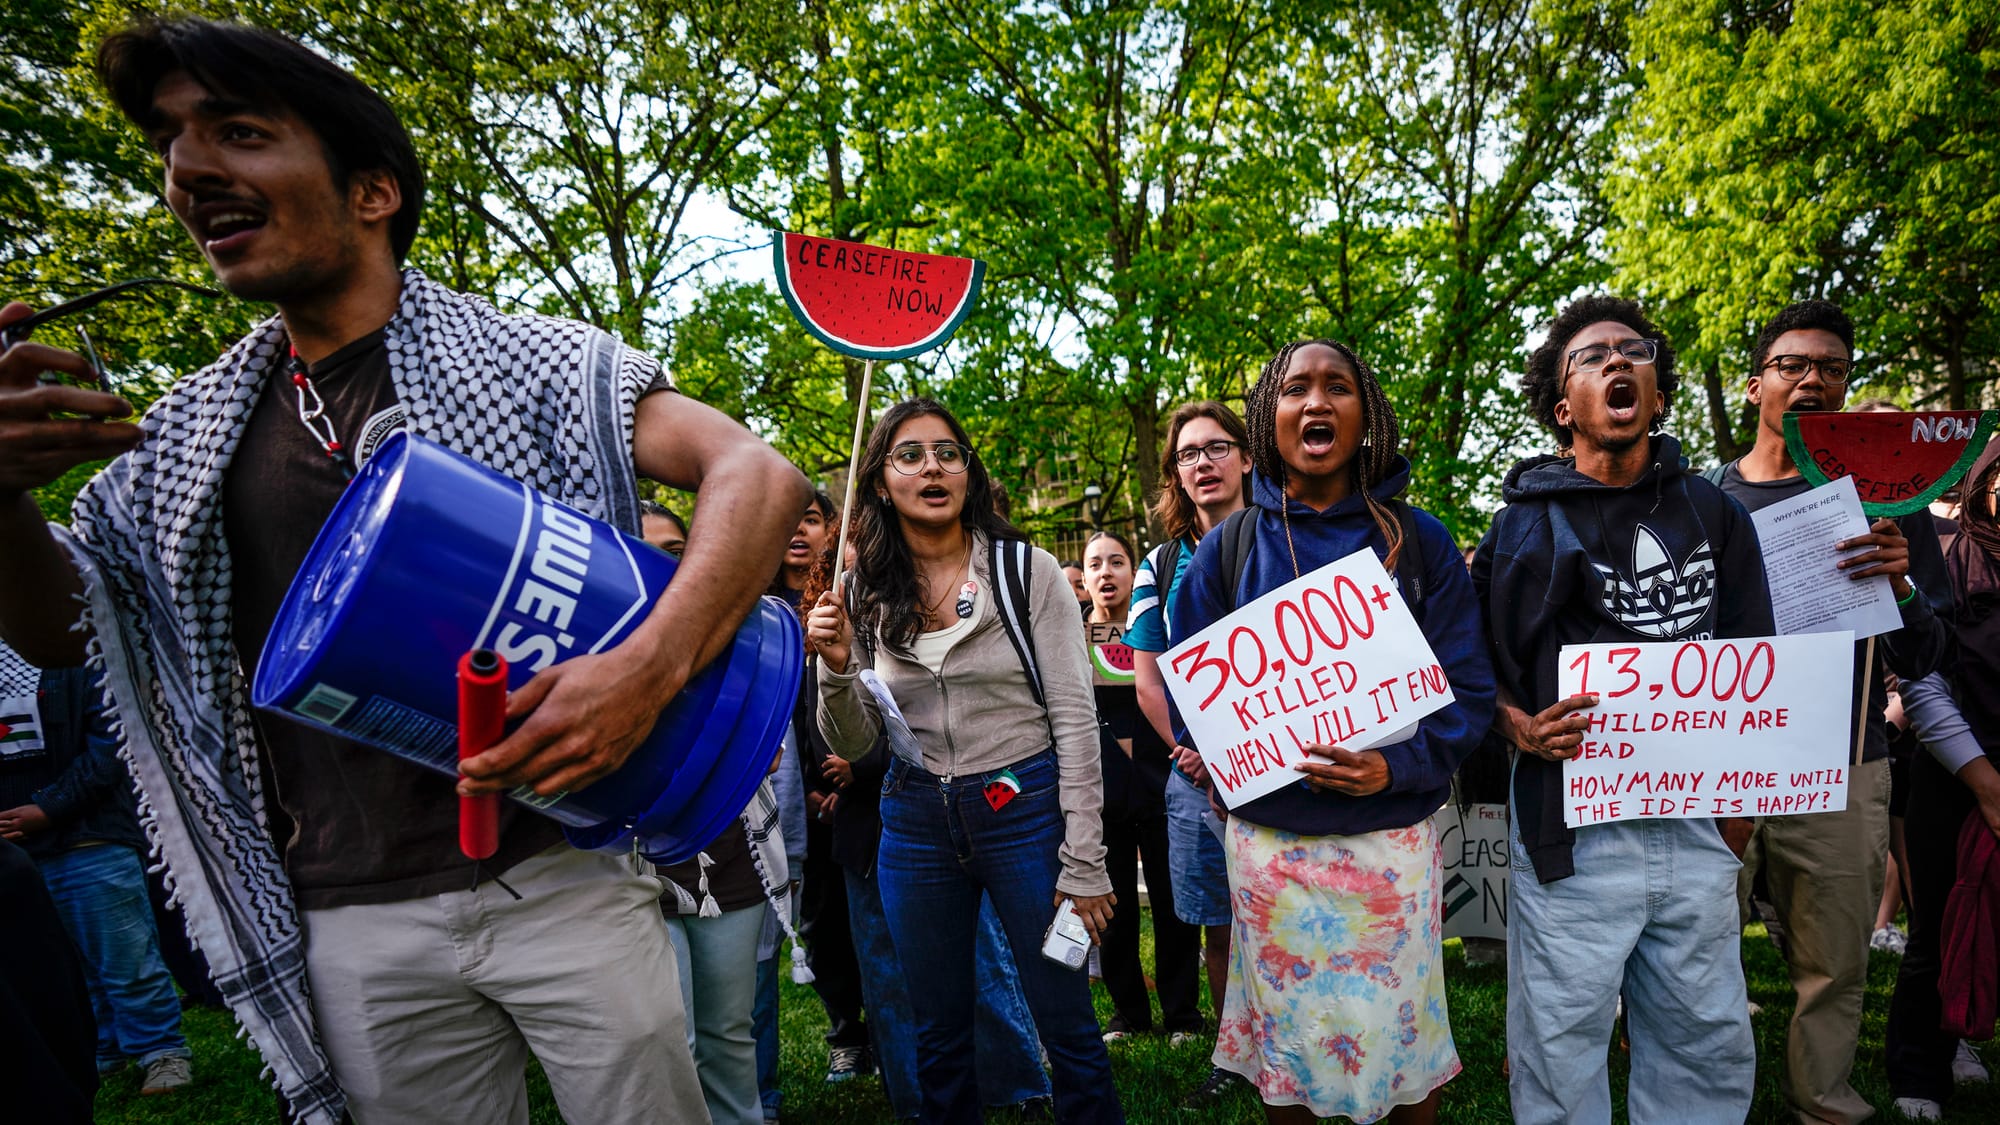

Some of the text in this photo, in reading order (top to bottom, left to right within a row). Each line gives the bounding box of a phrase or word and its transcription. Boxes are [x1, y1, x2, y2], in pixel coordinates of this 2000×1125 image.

[799, 239, 930, 284] CEASEFIRE
[887, 286, 946, 318] NOW.
[1911, 415, 1977, 443] NOW
[1773, 493, 1841, 524] WHY WE'RE HERE
[1171, 575, 1391, 712] 30,000+
[1569, 641, 1776, 703] 13,000
[1231, 660, 1358, 732] KILLED
[1210, 664, 1448, 793] WHEN WILL IT END
[1569, 708, 1790, 735] HILDREN ARE
[1570, 768, 1844, 799] HOW MANY MORE UNTIL
[1478, 806, 1505, 820] FREE
[1574, 791, 1832, 825] THE IDF IS HAPPY?
[1441, 824, 1511, 870] CEAS
